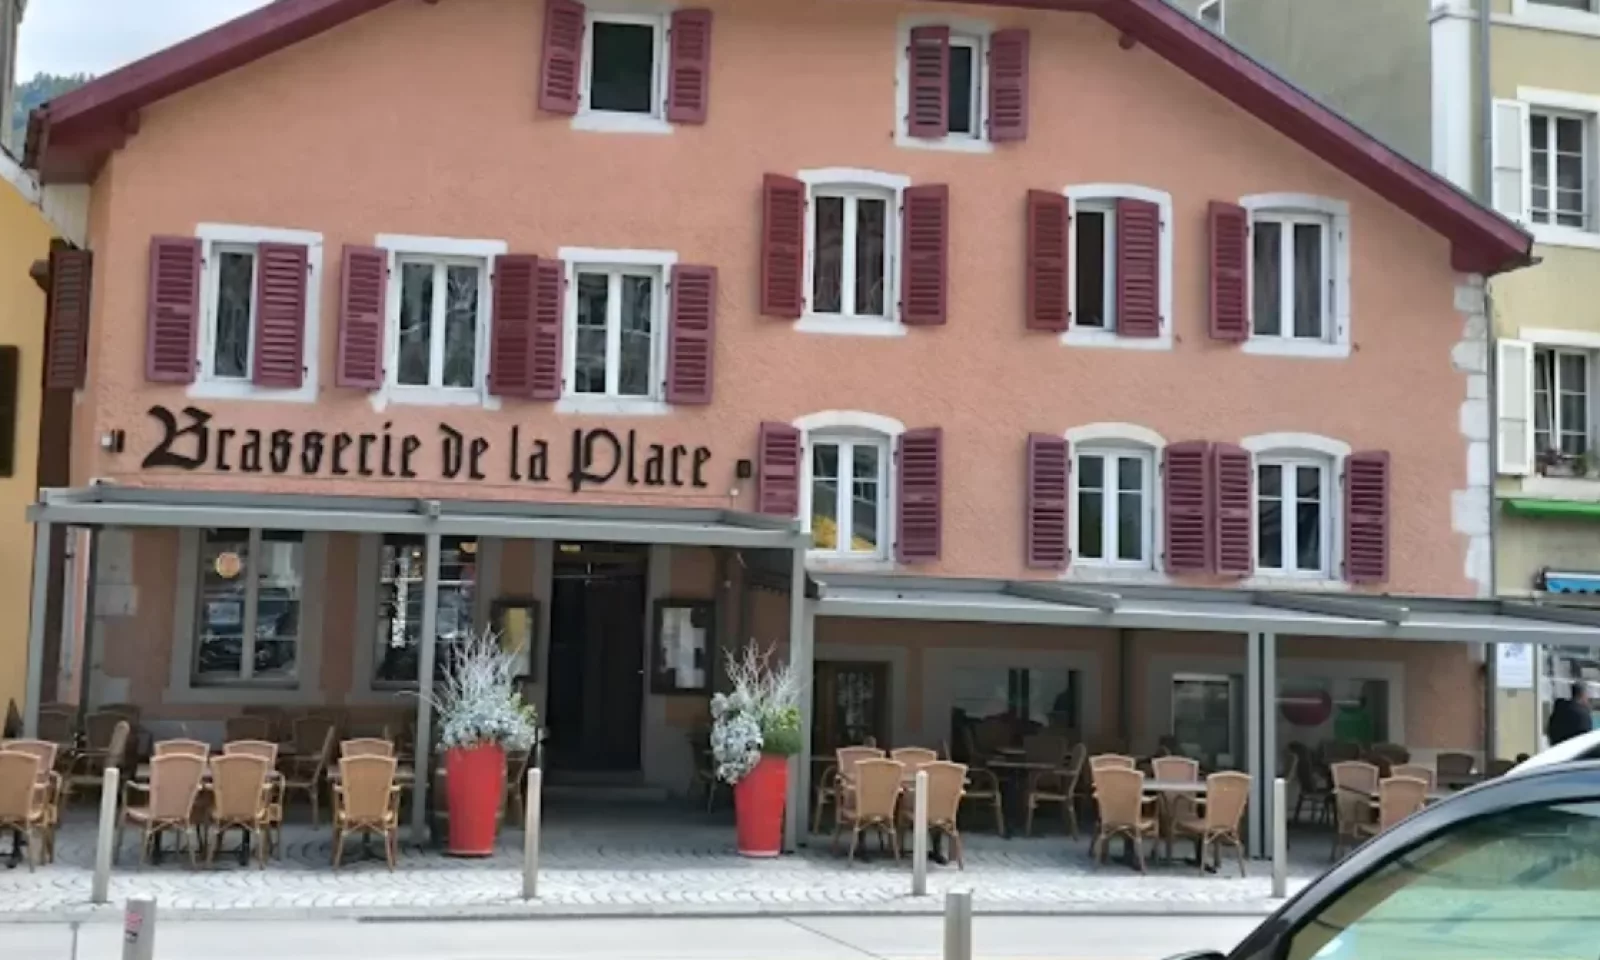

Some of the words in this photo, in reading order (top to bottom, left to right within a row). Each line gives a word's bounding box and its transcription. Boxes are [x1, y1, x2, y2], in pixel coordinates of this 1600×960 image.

[141, 404, 421, 478] Brasserie
[439, 422, 489, 480] de
[510, 425, 549, 482] la
[567, 427, 711, 492] Place
